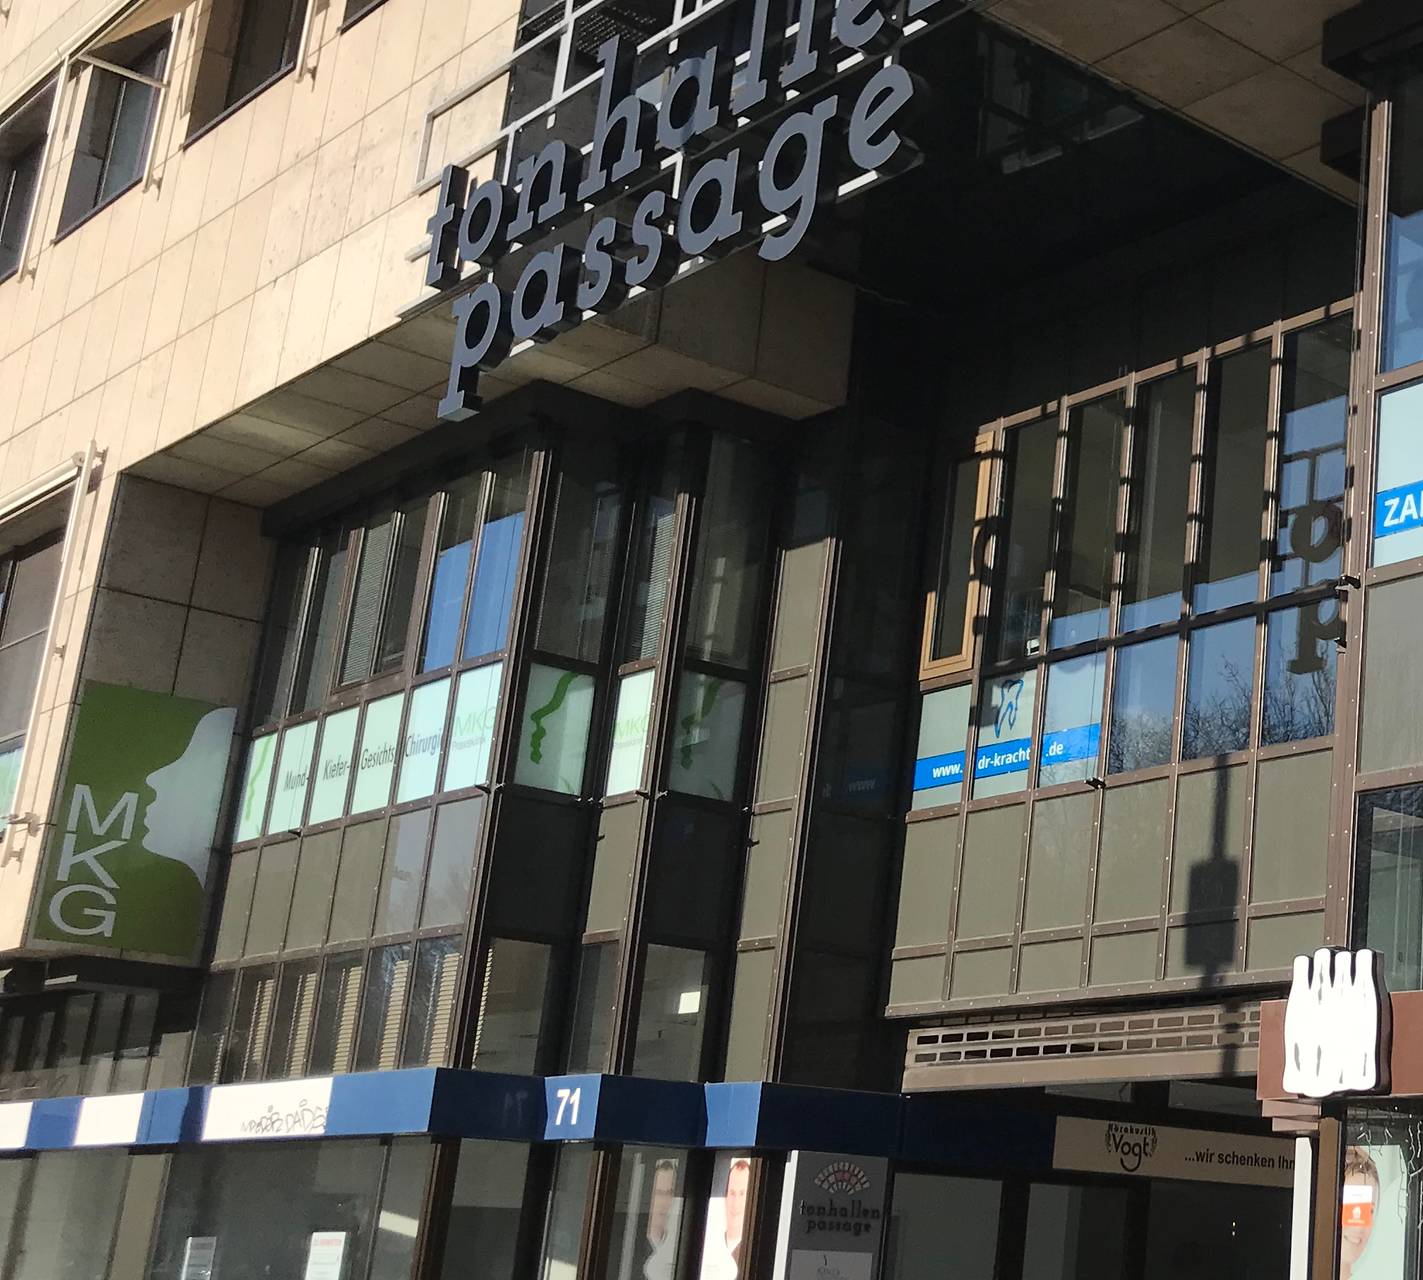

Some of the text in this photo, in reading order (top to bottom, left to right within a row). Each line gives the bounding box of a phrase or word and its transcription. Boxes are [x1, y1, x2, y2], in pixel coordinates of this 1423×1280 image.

[426, 0, 941, 288] tonhall
[437, 64, 915, 418] passage
[323, 754, 351, 781] Kiefer-
[932, 763, 964, 779] www.
[977, 747, 1032, 770] dr-kracht
[49, 783, 139, 938] MKG
[554, 1087, 581, 1126] 71
[1111, 1132, 1151, 1172] Vogt
[1184, 1148, 1215, 1163] ...wir
[1217, 1151, 1275, 1168] schenken
[799, 1198, 881, 1219] tonhallen
[806, 1219, 872, 1237] passage
